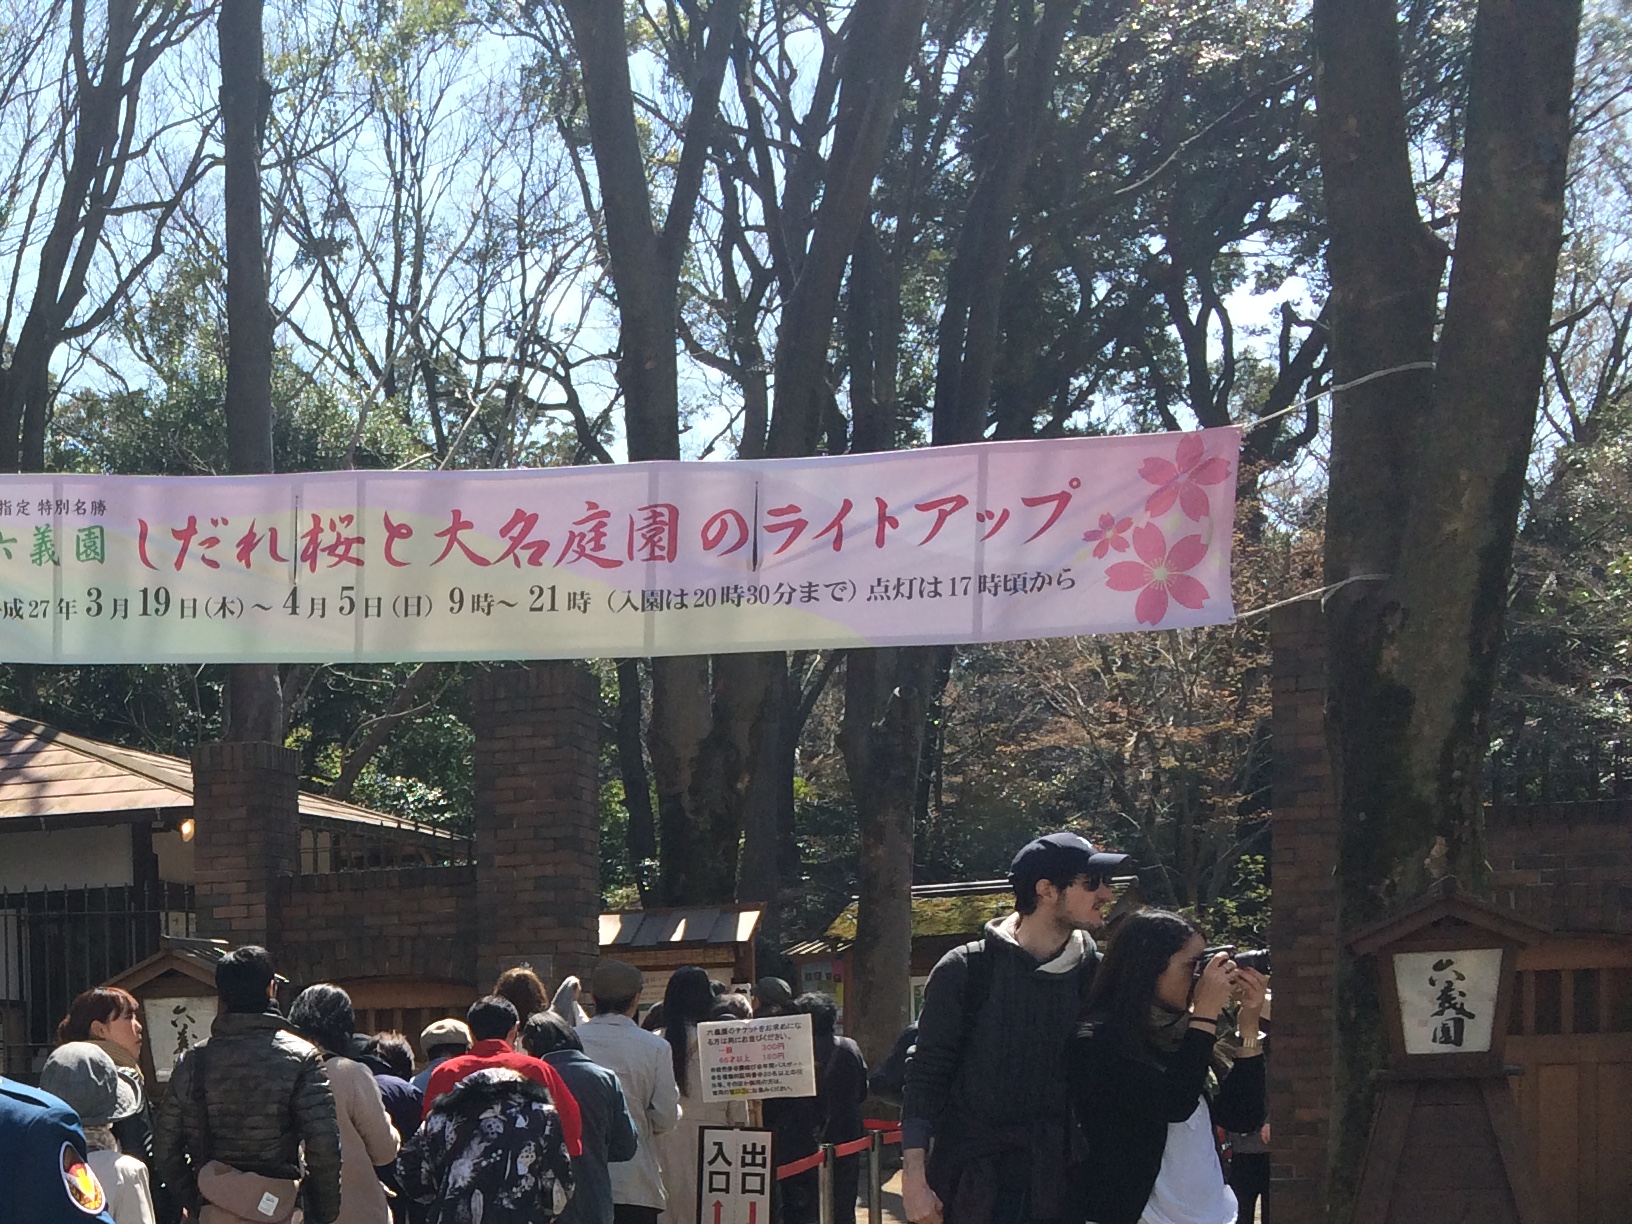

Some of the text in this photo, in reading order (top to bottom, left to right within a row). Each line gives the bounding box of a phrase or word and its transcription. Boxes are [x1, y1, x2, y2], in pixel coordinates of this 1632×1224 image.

[138, 477, 1082, 574] しだれ桜と大名庭園のライトアップ
[1428, 958, 1476, 1047] 六義園
[707, 1141, 733, 1195] 入口
[740, 1142, 766, 1196] 出口
